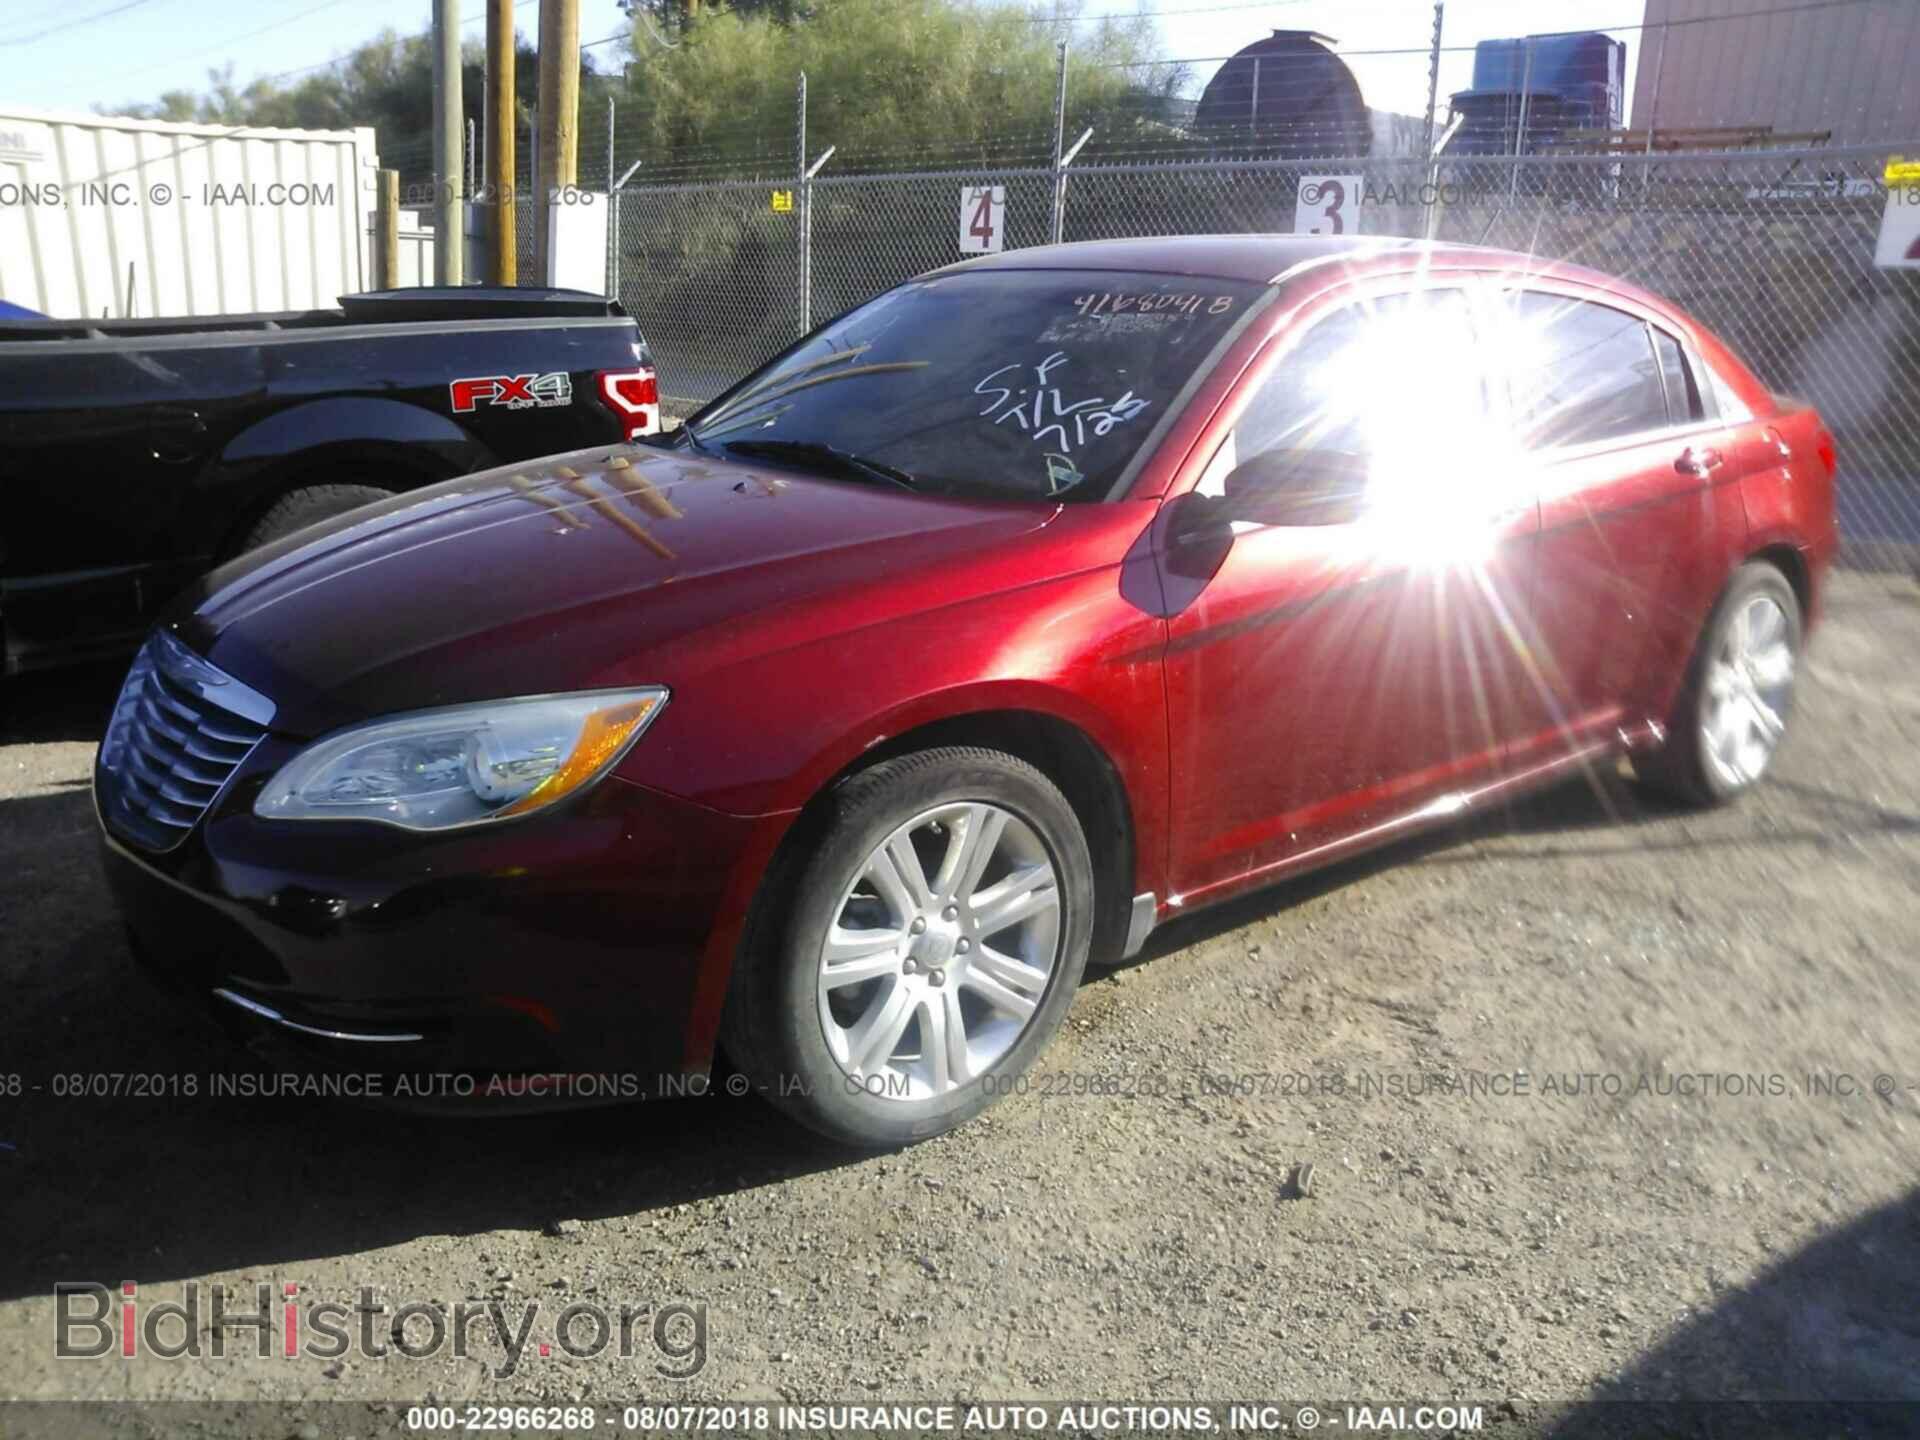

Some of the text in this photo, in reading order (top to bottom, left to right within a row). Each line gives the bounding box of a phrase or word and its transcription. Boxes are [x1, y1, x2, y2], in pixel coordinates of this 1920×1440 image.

[970, 190, 993, 248] 4
[1310, 180, 1345, 235] 3
[450, 371, 572, 413] FX4
